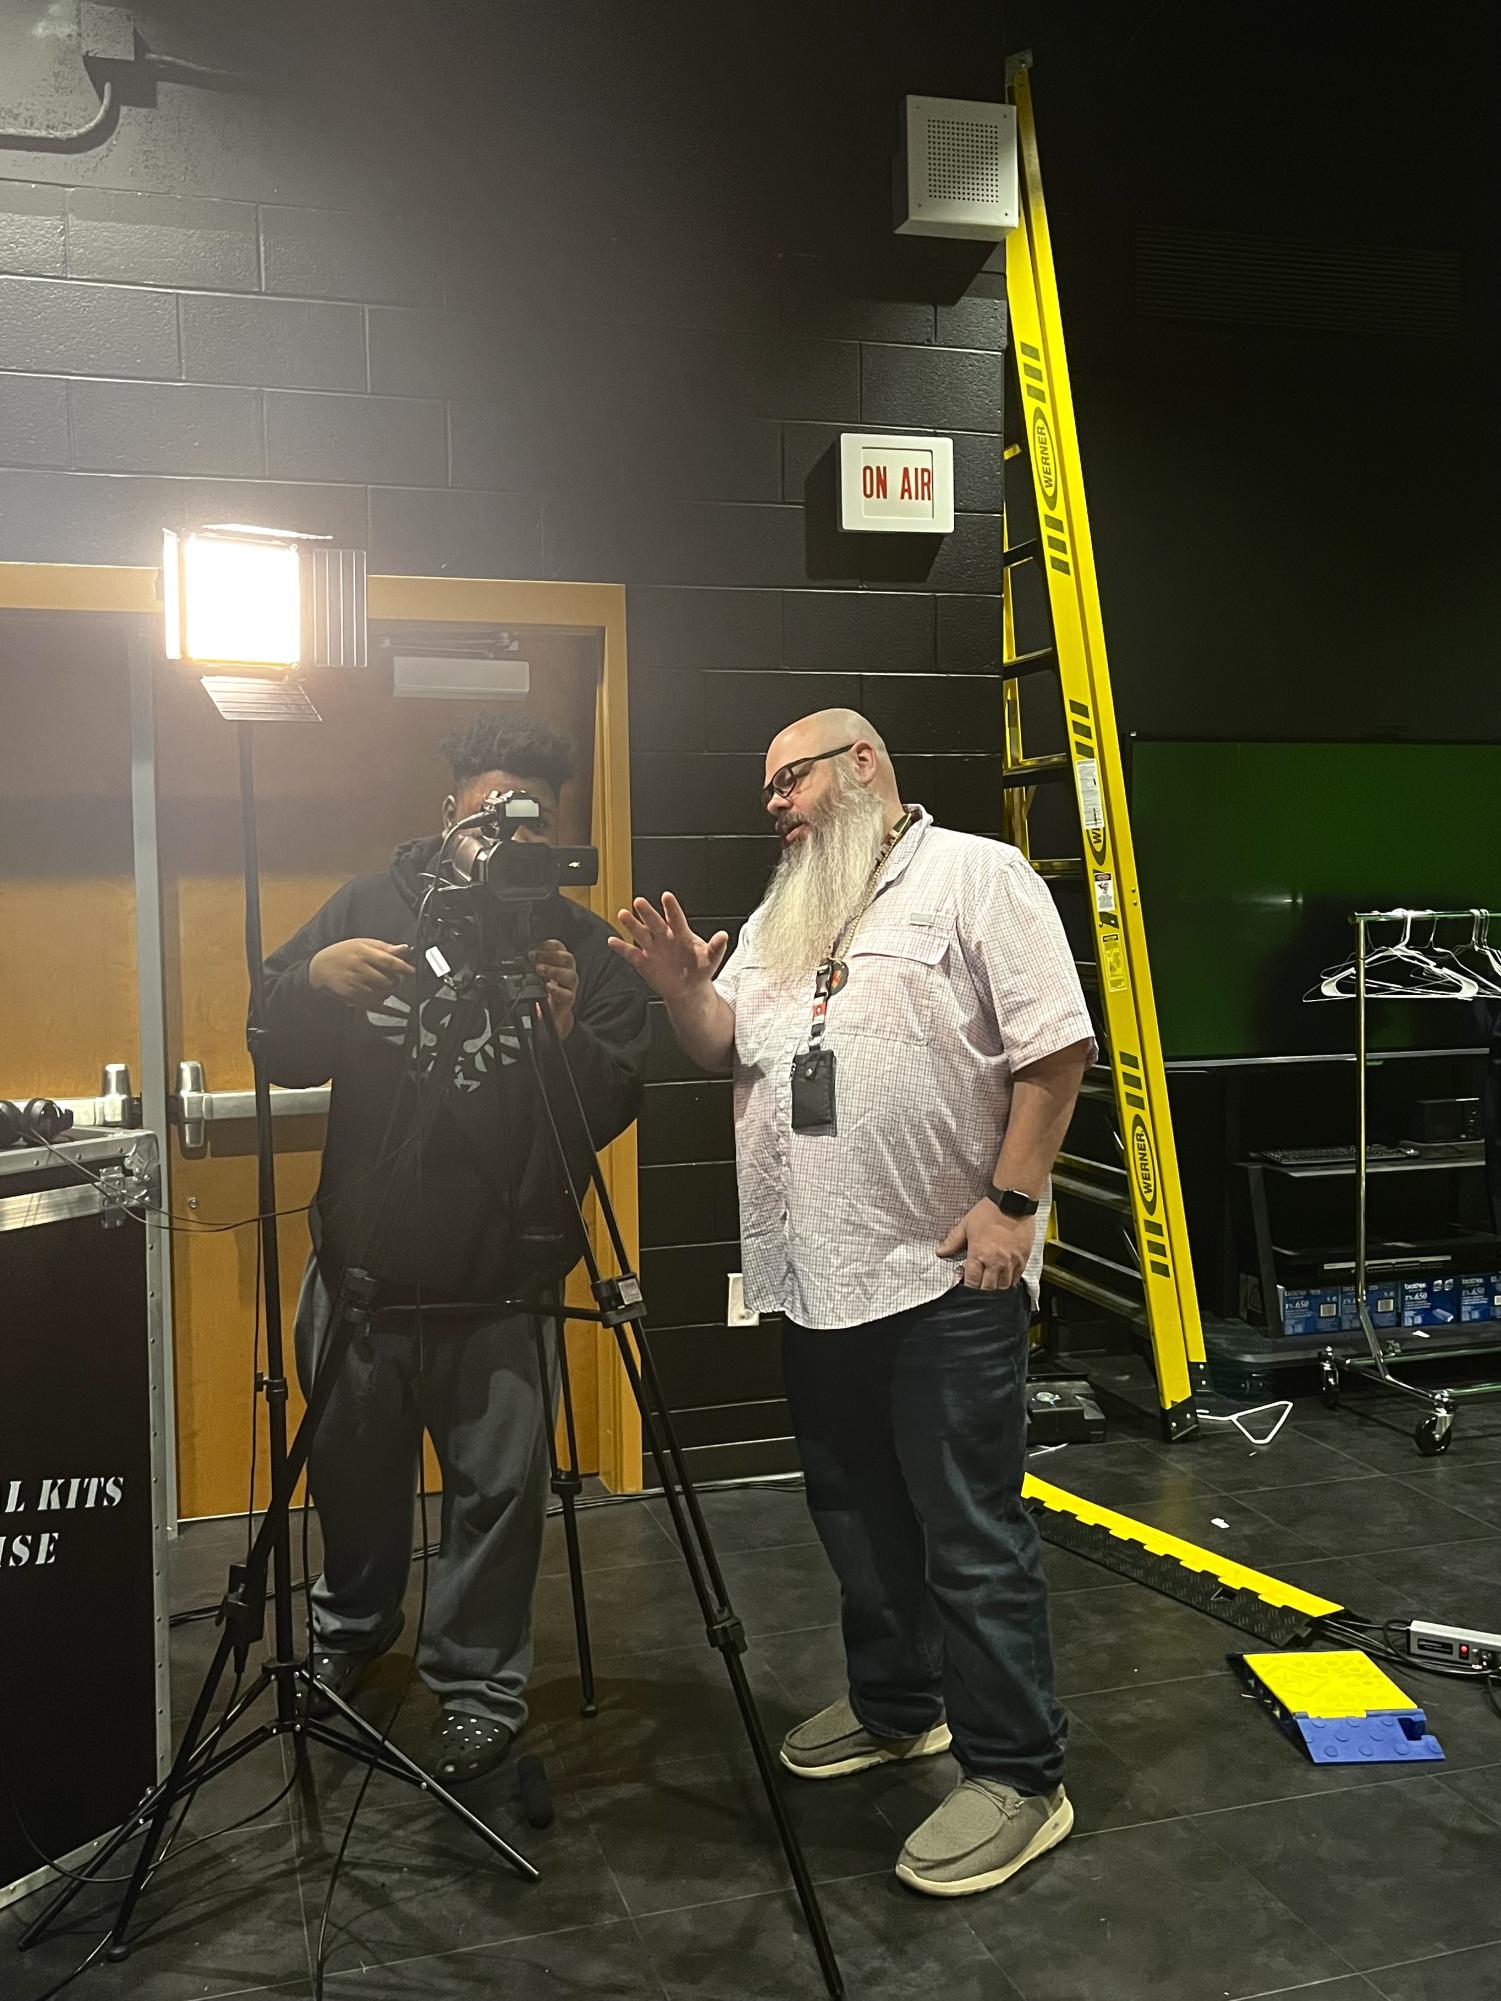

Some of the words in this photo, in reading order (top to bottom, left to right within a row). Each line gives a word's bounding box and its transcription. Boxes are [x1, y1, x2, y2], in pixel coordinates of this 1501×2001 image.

[1036, 426, 1053, 488] WERNER
[862, 465, 887, 499] ON
[900, 467, 932, 501] AIR
[1136, 1132, 1153, 1194] WERNER
[37, 1476, 124, 1511] KITS
